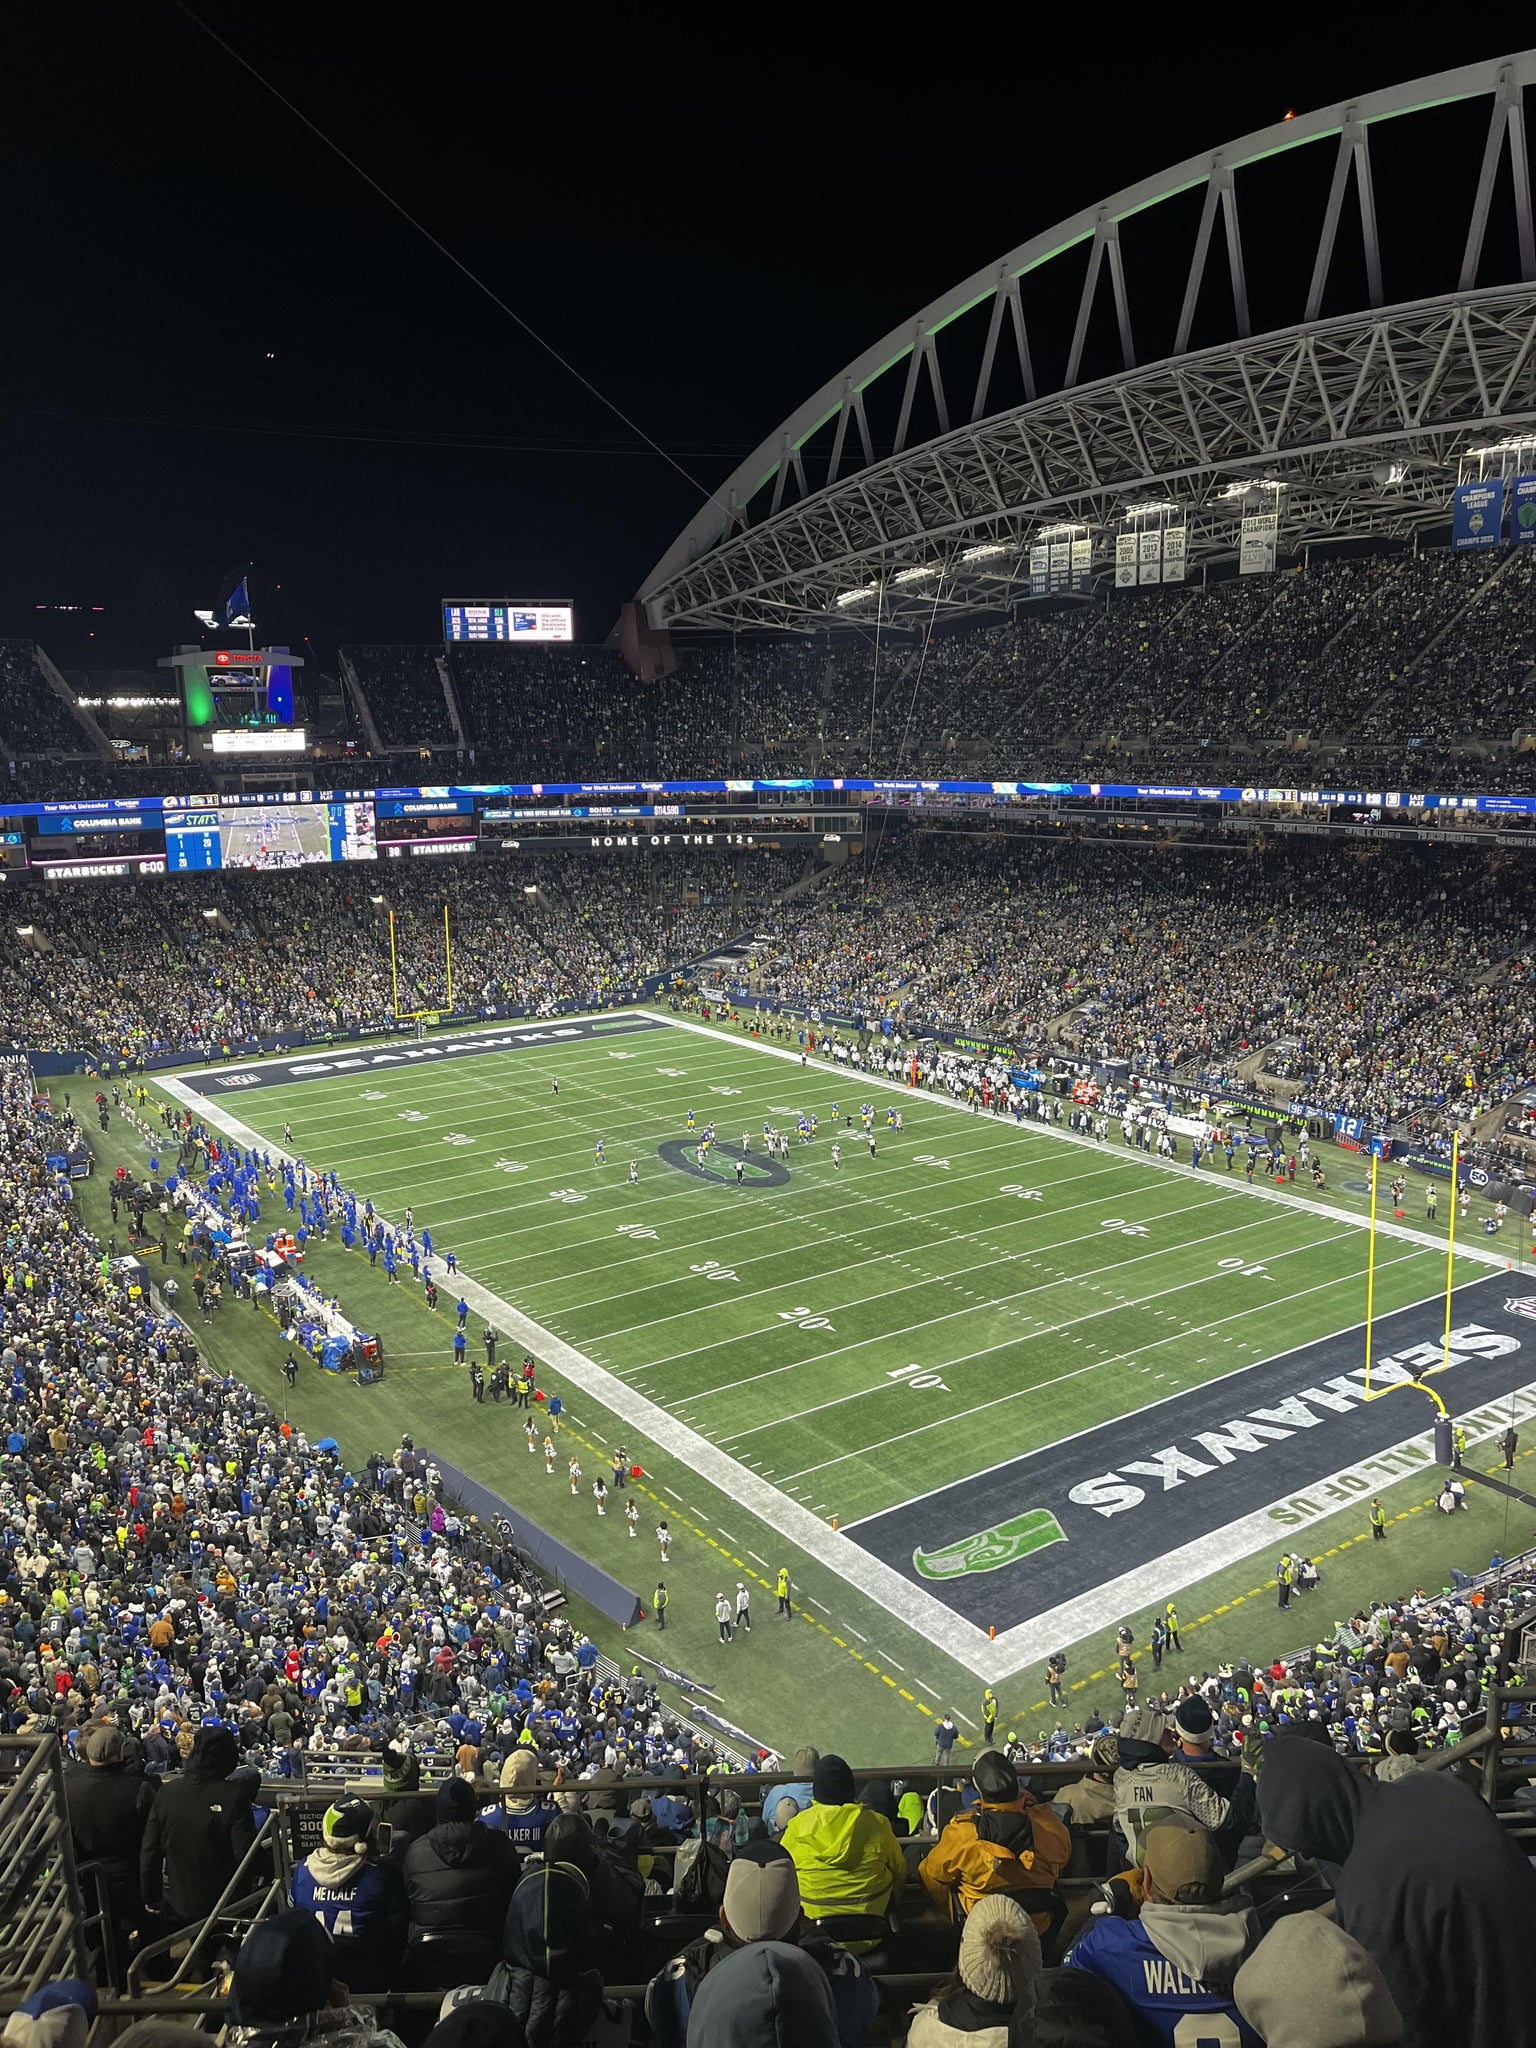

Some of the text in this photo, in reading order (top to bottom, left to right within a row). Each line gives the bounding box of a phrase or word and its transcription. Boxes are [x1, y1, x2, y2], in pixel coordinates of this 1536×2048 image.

[1461, 491, 1496, 503] CHAMPIONS
[1467, 500, 1488, 509] LEAGUE
[1243, 515, 1277, 527] 2013 WORLD
[1243, 523, 1276, 534] CHAMPIONS
[1142, 544, 1158, 553] 2013
[1166, 541, 1182, 550] 2014
[231, 654, 264, 662] TOYOTA
[78, 802, 109, 810] Unleashed
[403, 802, 458, 812] COLUMBIA BANK
[73, 816, 142, 828] COLUMBIA BANK
[186, 813, 217, 826] STATS
[1372, 830, 1389, 838] ALLEN
[1417, 832, 1426, 840] 79
[203, 839, 211, 847] 20
[591, 835, 753, 847] HOME OF THE 12s
[1507, 837, 1527, 846] KENNY
[413, 843, 472, 855] STARBUCKS
[178, 859, 187, 867] 20
[47, 865, 123, 878] STARBUCKS
[287, 1027, 584, 1076] SEAHAWKS
[1339, 1116, 1358, 1137] 12
[549, 1188, 588, 1203] 50
[999, 1184, 1043, 1200] 30
[615, 1223, 657, 1239] 40
[1100, 1218, 1147, 1236] 20
[690, 1260, 737, 1281] 30
[1217, 1257, 1268, 1277] 10
[777, 1306, 831, 1330] 20
[886, 1363, 943, 1389] 10
[1068, 1323, 1522, 1518] SEAHAWKS
[1363, 1444, 1431, 1476] ALL
[1323, 1475, 1370, 1502] OF
[1268, 1497, 1327, 1525] US
[1133, 1786, 1154, 1802] FAN
[300, 1821, 323, 1832] 300
[508, 1828, 531, 1841] LKER
[312, 1886, 358, 1901] METCALF
